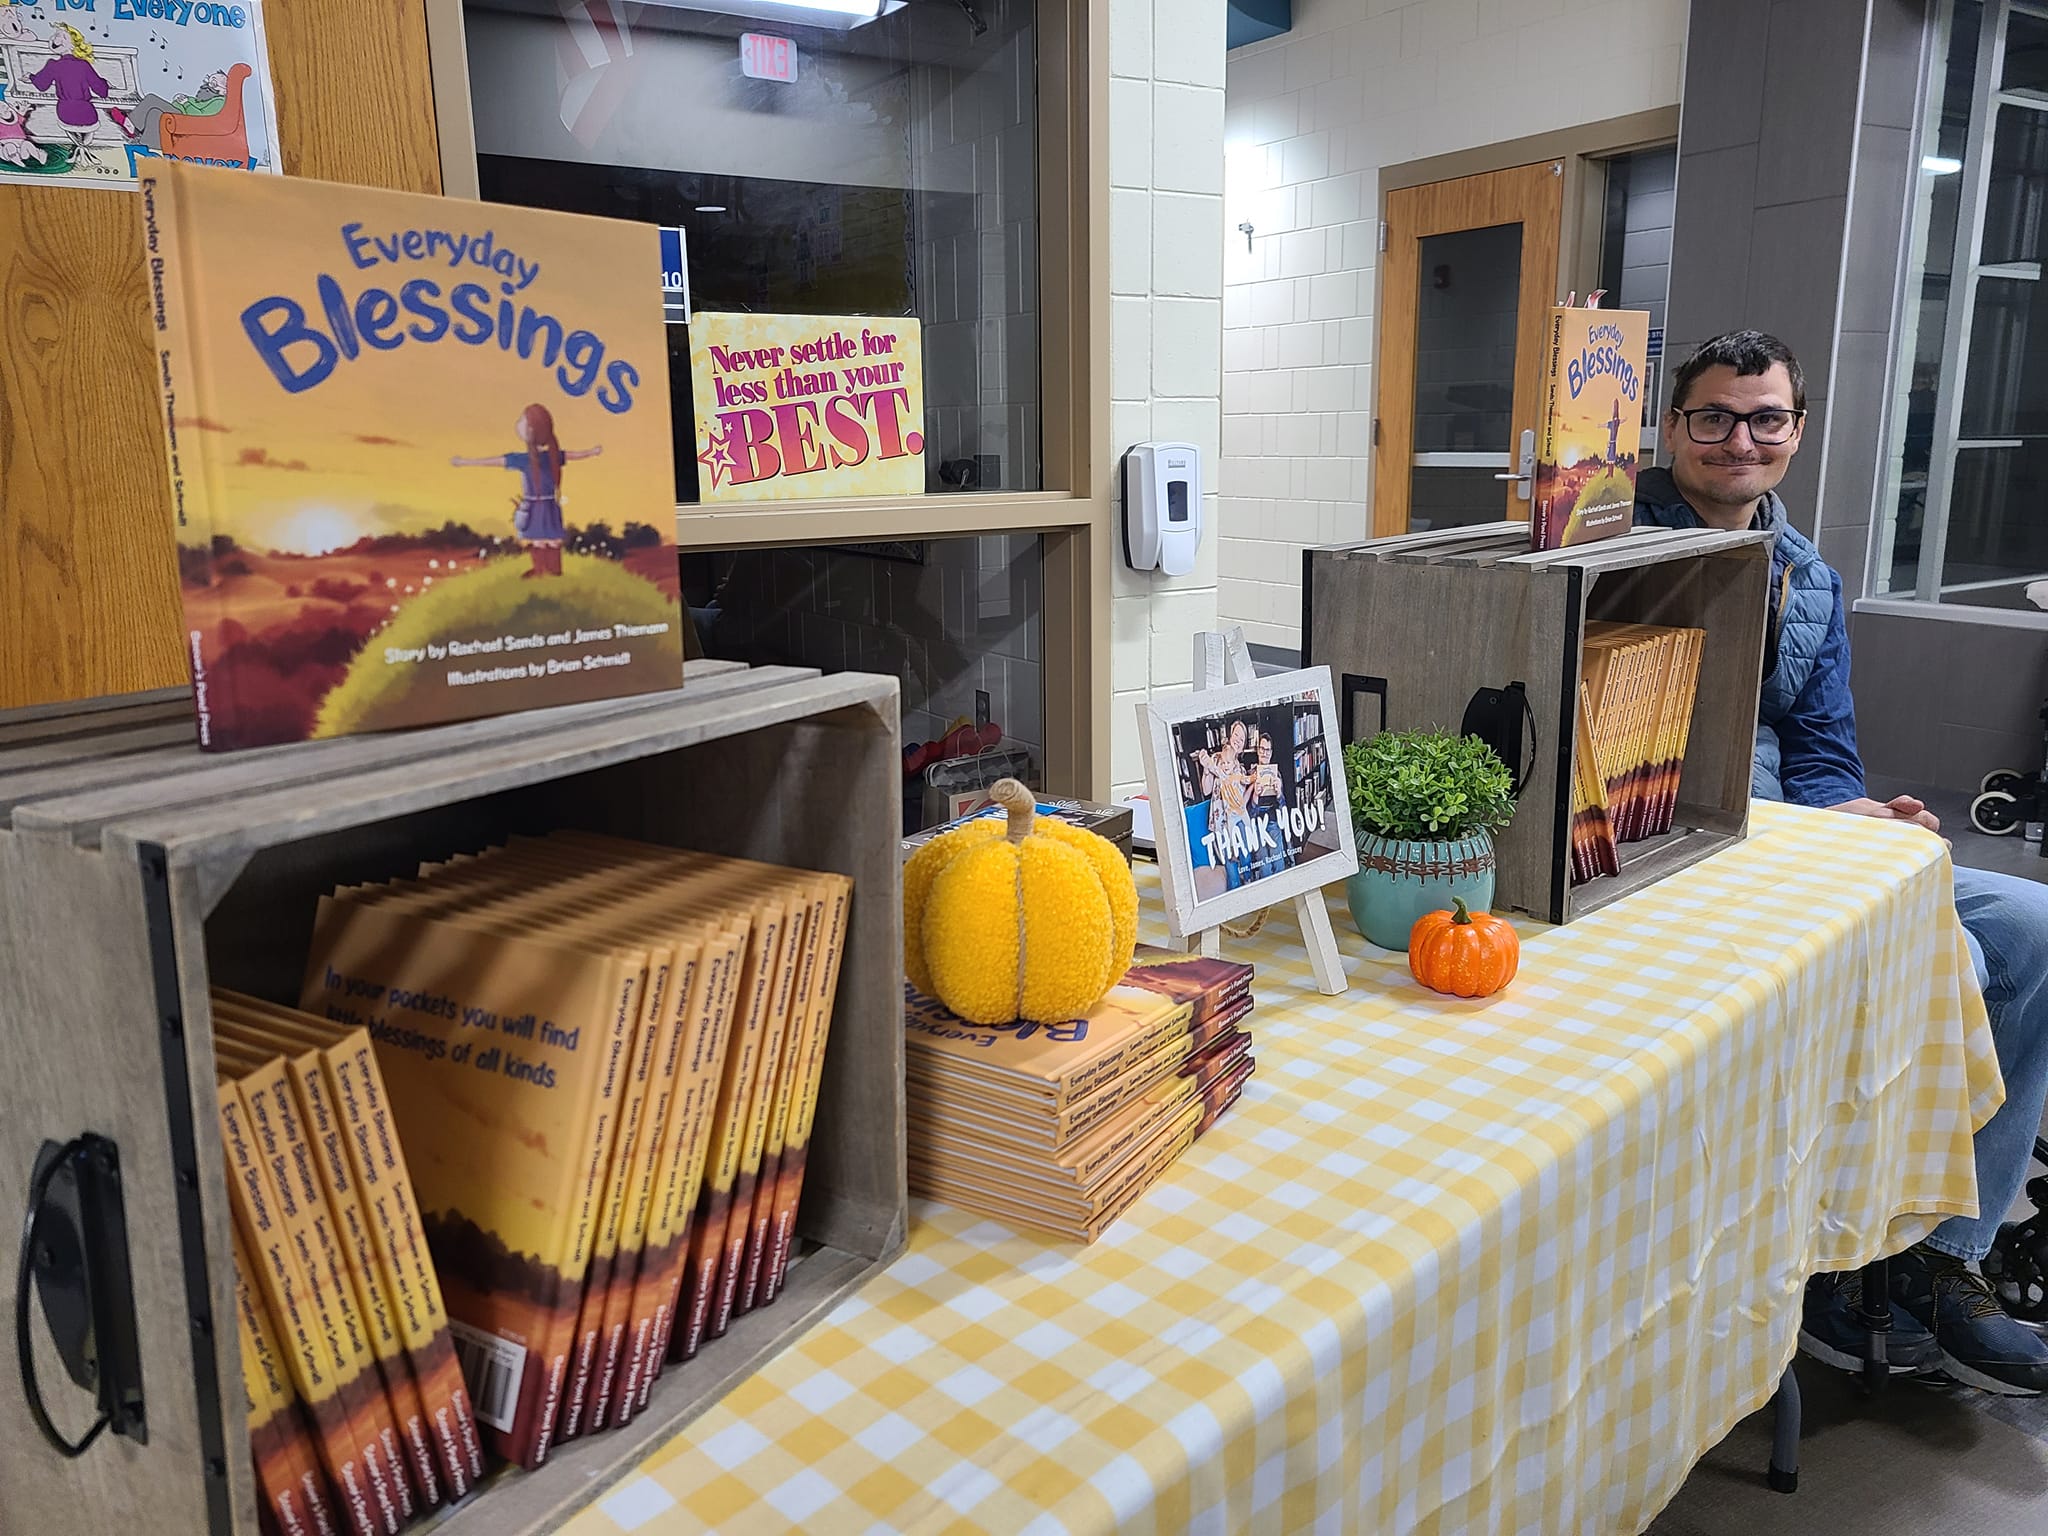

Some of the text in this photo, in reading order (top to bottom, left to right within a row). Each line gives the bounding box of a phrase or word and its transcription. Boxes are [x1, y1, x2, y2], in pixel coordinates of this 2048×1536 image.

[114, 0, 246, 28] Everyone
[143, 178, 160, 253] Everyday
[341, 222, 539, 290] Everyday
[662, 272, 682, 288] 10
[151, 258, 167, 331] Blessings
[240, 272, 640, 415] Blessings
[708, 328, 897, 376] Never settle for
[1553, 315, 1562, 347] Everyday
[1588, 323, 1624, 350] Everyday
[713, 361, 905, 408] less than your
[1551, 347, 1560, 377] Blessings
[1568, 346, 1639, 401] Blessings
[715, 387, 925, 486] BEST.
[384, 623, 669, 665] Story by Rachael Sands and James Thiemann
[447, 652, 631, 687] Illustrations by Brian Schmidt
[1201, 799, 1326, 870] THANK YOU!
[325, 965, 579, 1051] In your pockets you will find
[326, 1004, 364, 1025] little
[369, 1015, 446, 1060] blessings
[452, 1044, 472, 1064] of
[475, 1049, 500, 1073] all
[1066, 1084, 1093, 1105] Everyday
[1070, 1067, 1098, 1088] Everyday
[304, 1069, 329, 1132] Everyday
[323, 1131, 348, 1193] Blessings
[337, 1061, 359, 1123] Everyday
[355, 1123, 378, 1184] Blessings
[355, 1048, 396, 1169] Everyday Blessings
[1070, 1103, 1097, 1124] Everyday
[221, 1102, 271, 1231] Everyday Blessings
[251, 1090, 276, 1155] Everyday
[271, 1154, 297, 1218] Blessings
[272, 1078, 317, 1204] Everyday Blessings
[1085, 1152, 1110, 1174] Everyday
